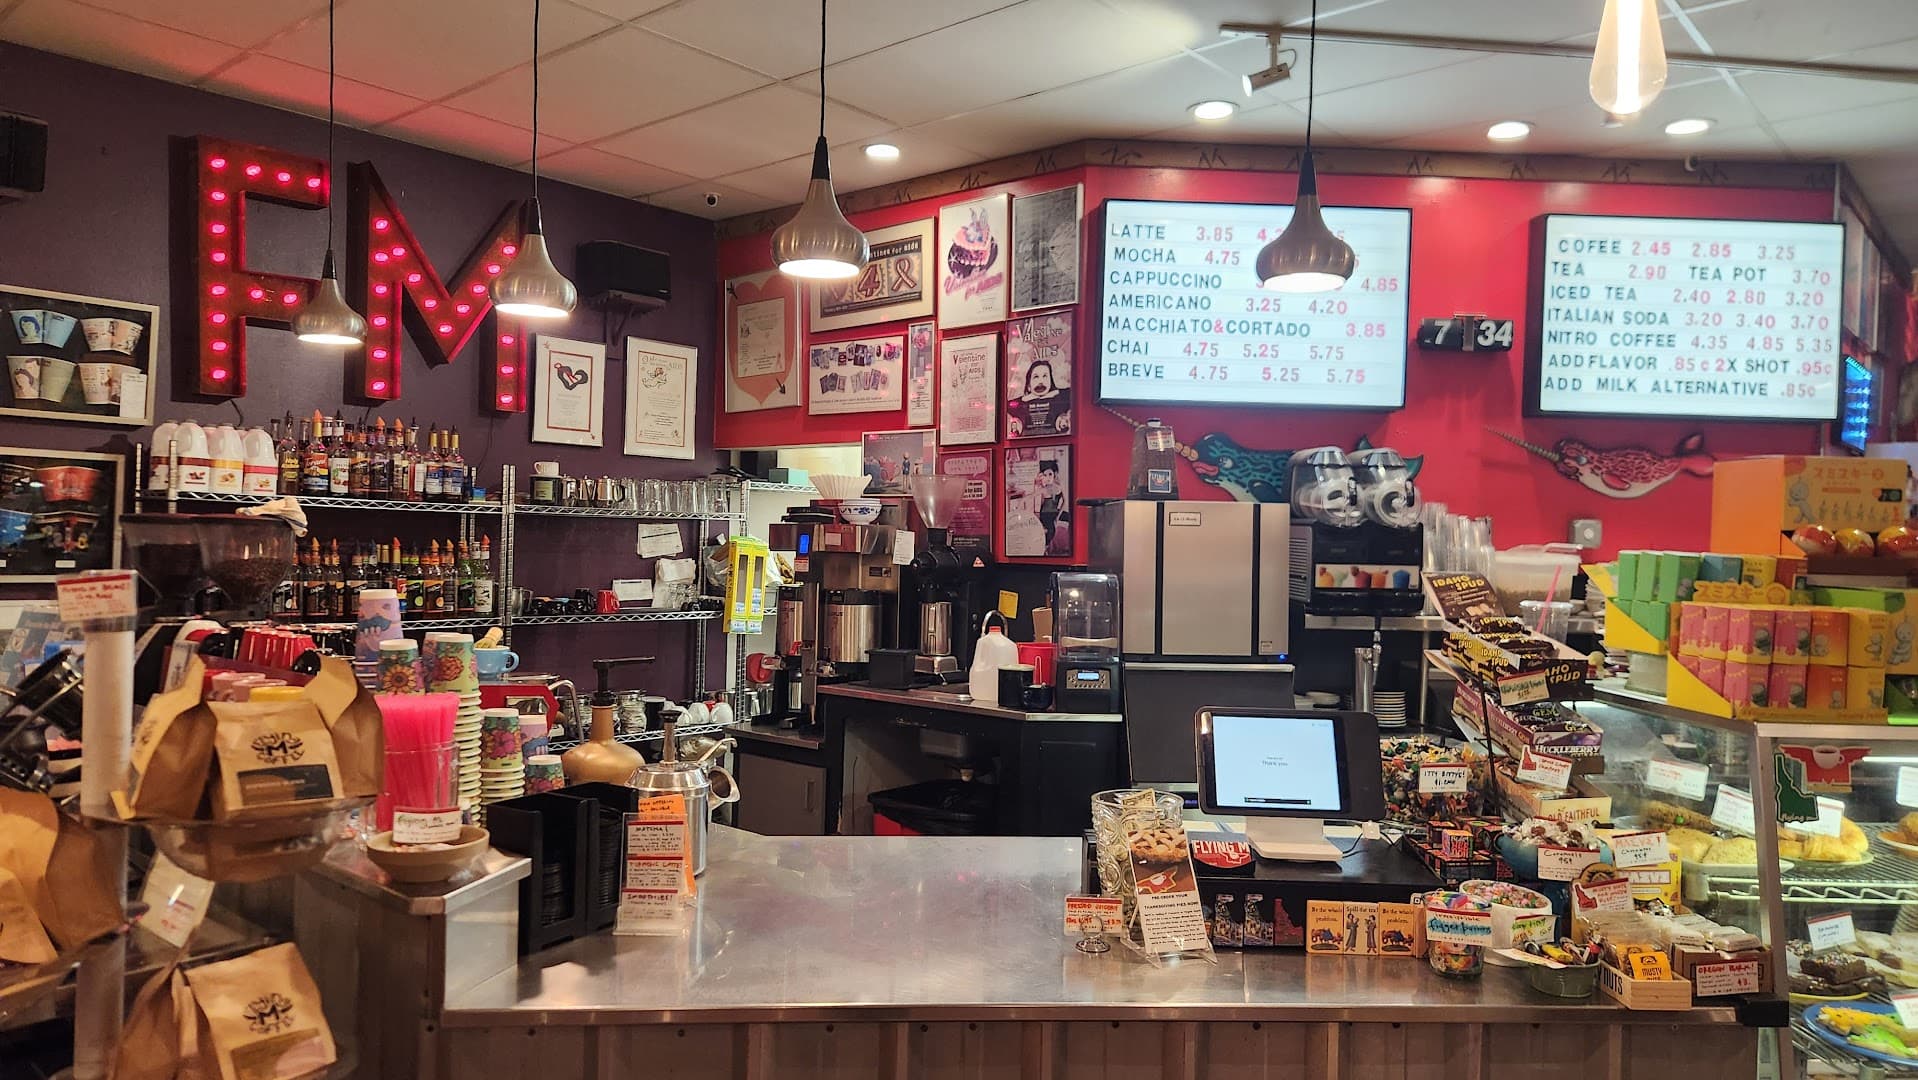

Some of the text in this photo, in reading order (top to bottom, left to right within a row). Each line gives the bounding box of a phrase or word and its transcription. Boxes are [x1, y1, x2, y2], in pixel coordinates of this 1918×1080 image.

[1111, 224, 1166, 240] LATTE
[1196, 226, 1233, 241] 3.85
[1113, 246, 1240, 265] MOCHA 4.75
[1559, 239, 1796, 260] COFEE 2.45 2.85 3.25
[858, 263, 881, 298] 4
[1109, 270, 1398, 292] CAPPUCCINO 4.85
[1551, 261, 1830, 285] TEA 2.90 TEA POT 3.70
[1108, 294, 1347, 315] AMERICANO 3.25 4.20
[1551, 286, 1824, 307] ICED TEA 2.40 2.80 3.20
[1548, 309, 1829, 330] ITALIAN SODA 3.20 3.40 3.70
[1346, 324, 1385, 338] 3.85
[1434, 320, 1513, 347] 7 34
[1107, 340, 1344, 360] CHAI 4.75 5.25 5.75
[1547, 331, 1832, 353] NITRO COFFEE 4.35 4.85 5.35
[1108, 363, 1365, 383] BREVE 4.75 5.25 5.75
[1745, 359, 1790, 374] SHOT
[1544, 376, 1583, 391] ADD
[1596, 378, 1638, 392] MILK
[1650, 379, 1769, 396] ALTERNATIVE
[1432, 575, 1469, 588] IDAHO
[1455, 579, 1485, 591] SPUD
[1535, 744, 1600, 754] HUCKLEBERRY
[1565, 807, 1600, 822] FAITHFUL
[1192, 840, 1250, 854] FLYING M
